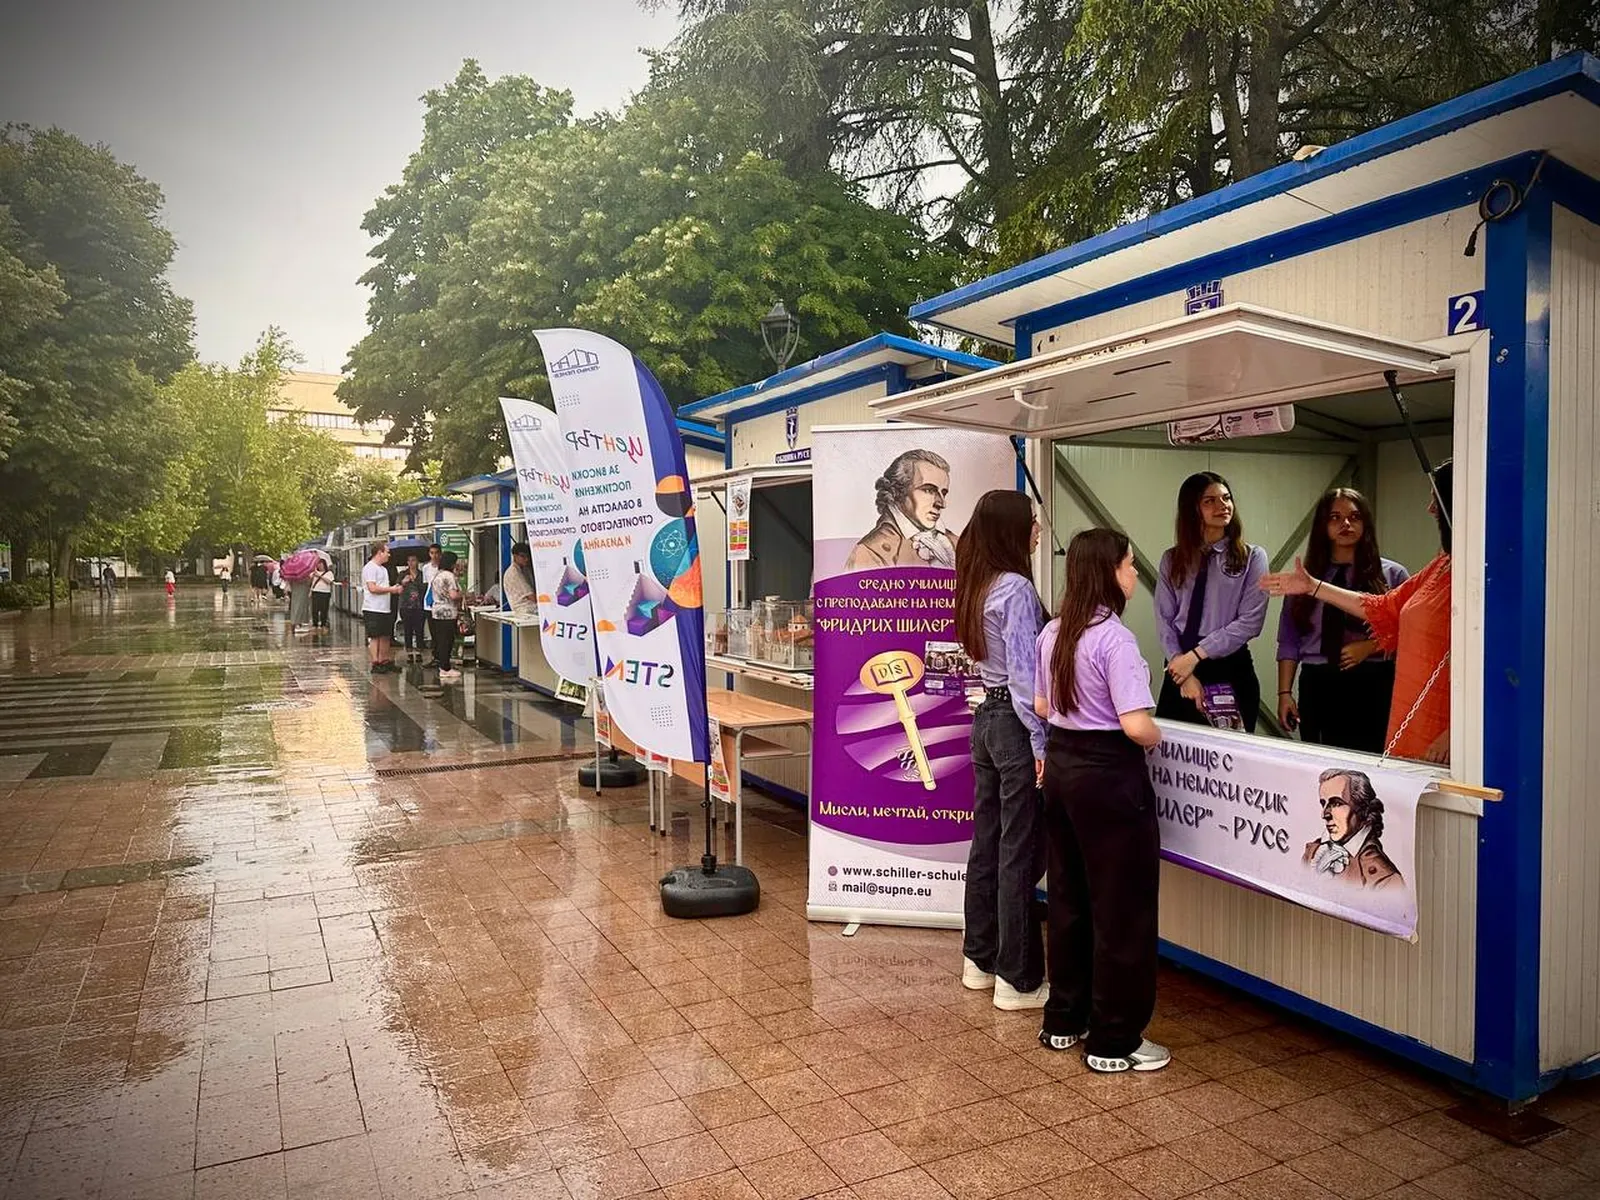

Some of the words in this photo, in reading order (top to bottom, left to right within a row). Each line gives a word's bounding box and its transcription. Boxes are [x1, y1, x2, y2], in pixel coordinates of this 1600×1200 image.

[1453, 295, 1477, 334] 2
[858, 579, 905, 592] СРЕДНО
[816, 599, 823, 608] С
[824, 598, 909, 611] ПРЕПОДАВАНЕ
[911, 599, 927, 609] НА
[1149, 740, 1219, 773] ЧИЛИЩЕ
[1222, 753, 1233, 773] С
[1151, 764, 1173, 788] НА
[1176, 770, 1240, 803] НЕМСКИ
[1243, 786, 1289, 816] ЕЗИК
[819, 801, 870, 818] Мисли,
[873, 806, 929, 820] мечтай,
[1234, 816, 1290, 854] РУСЕ
[842, 882, 931, 897] mail@supne.eu
